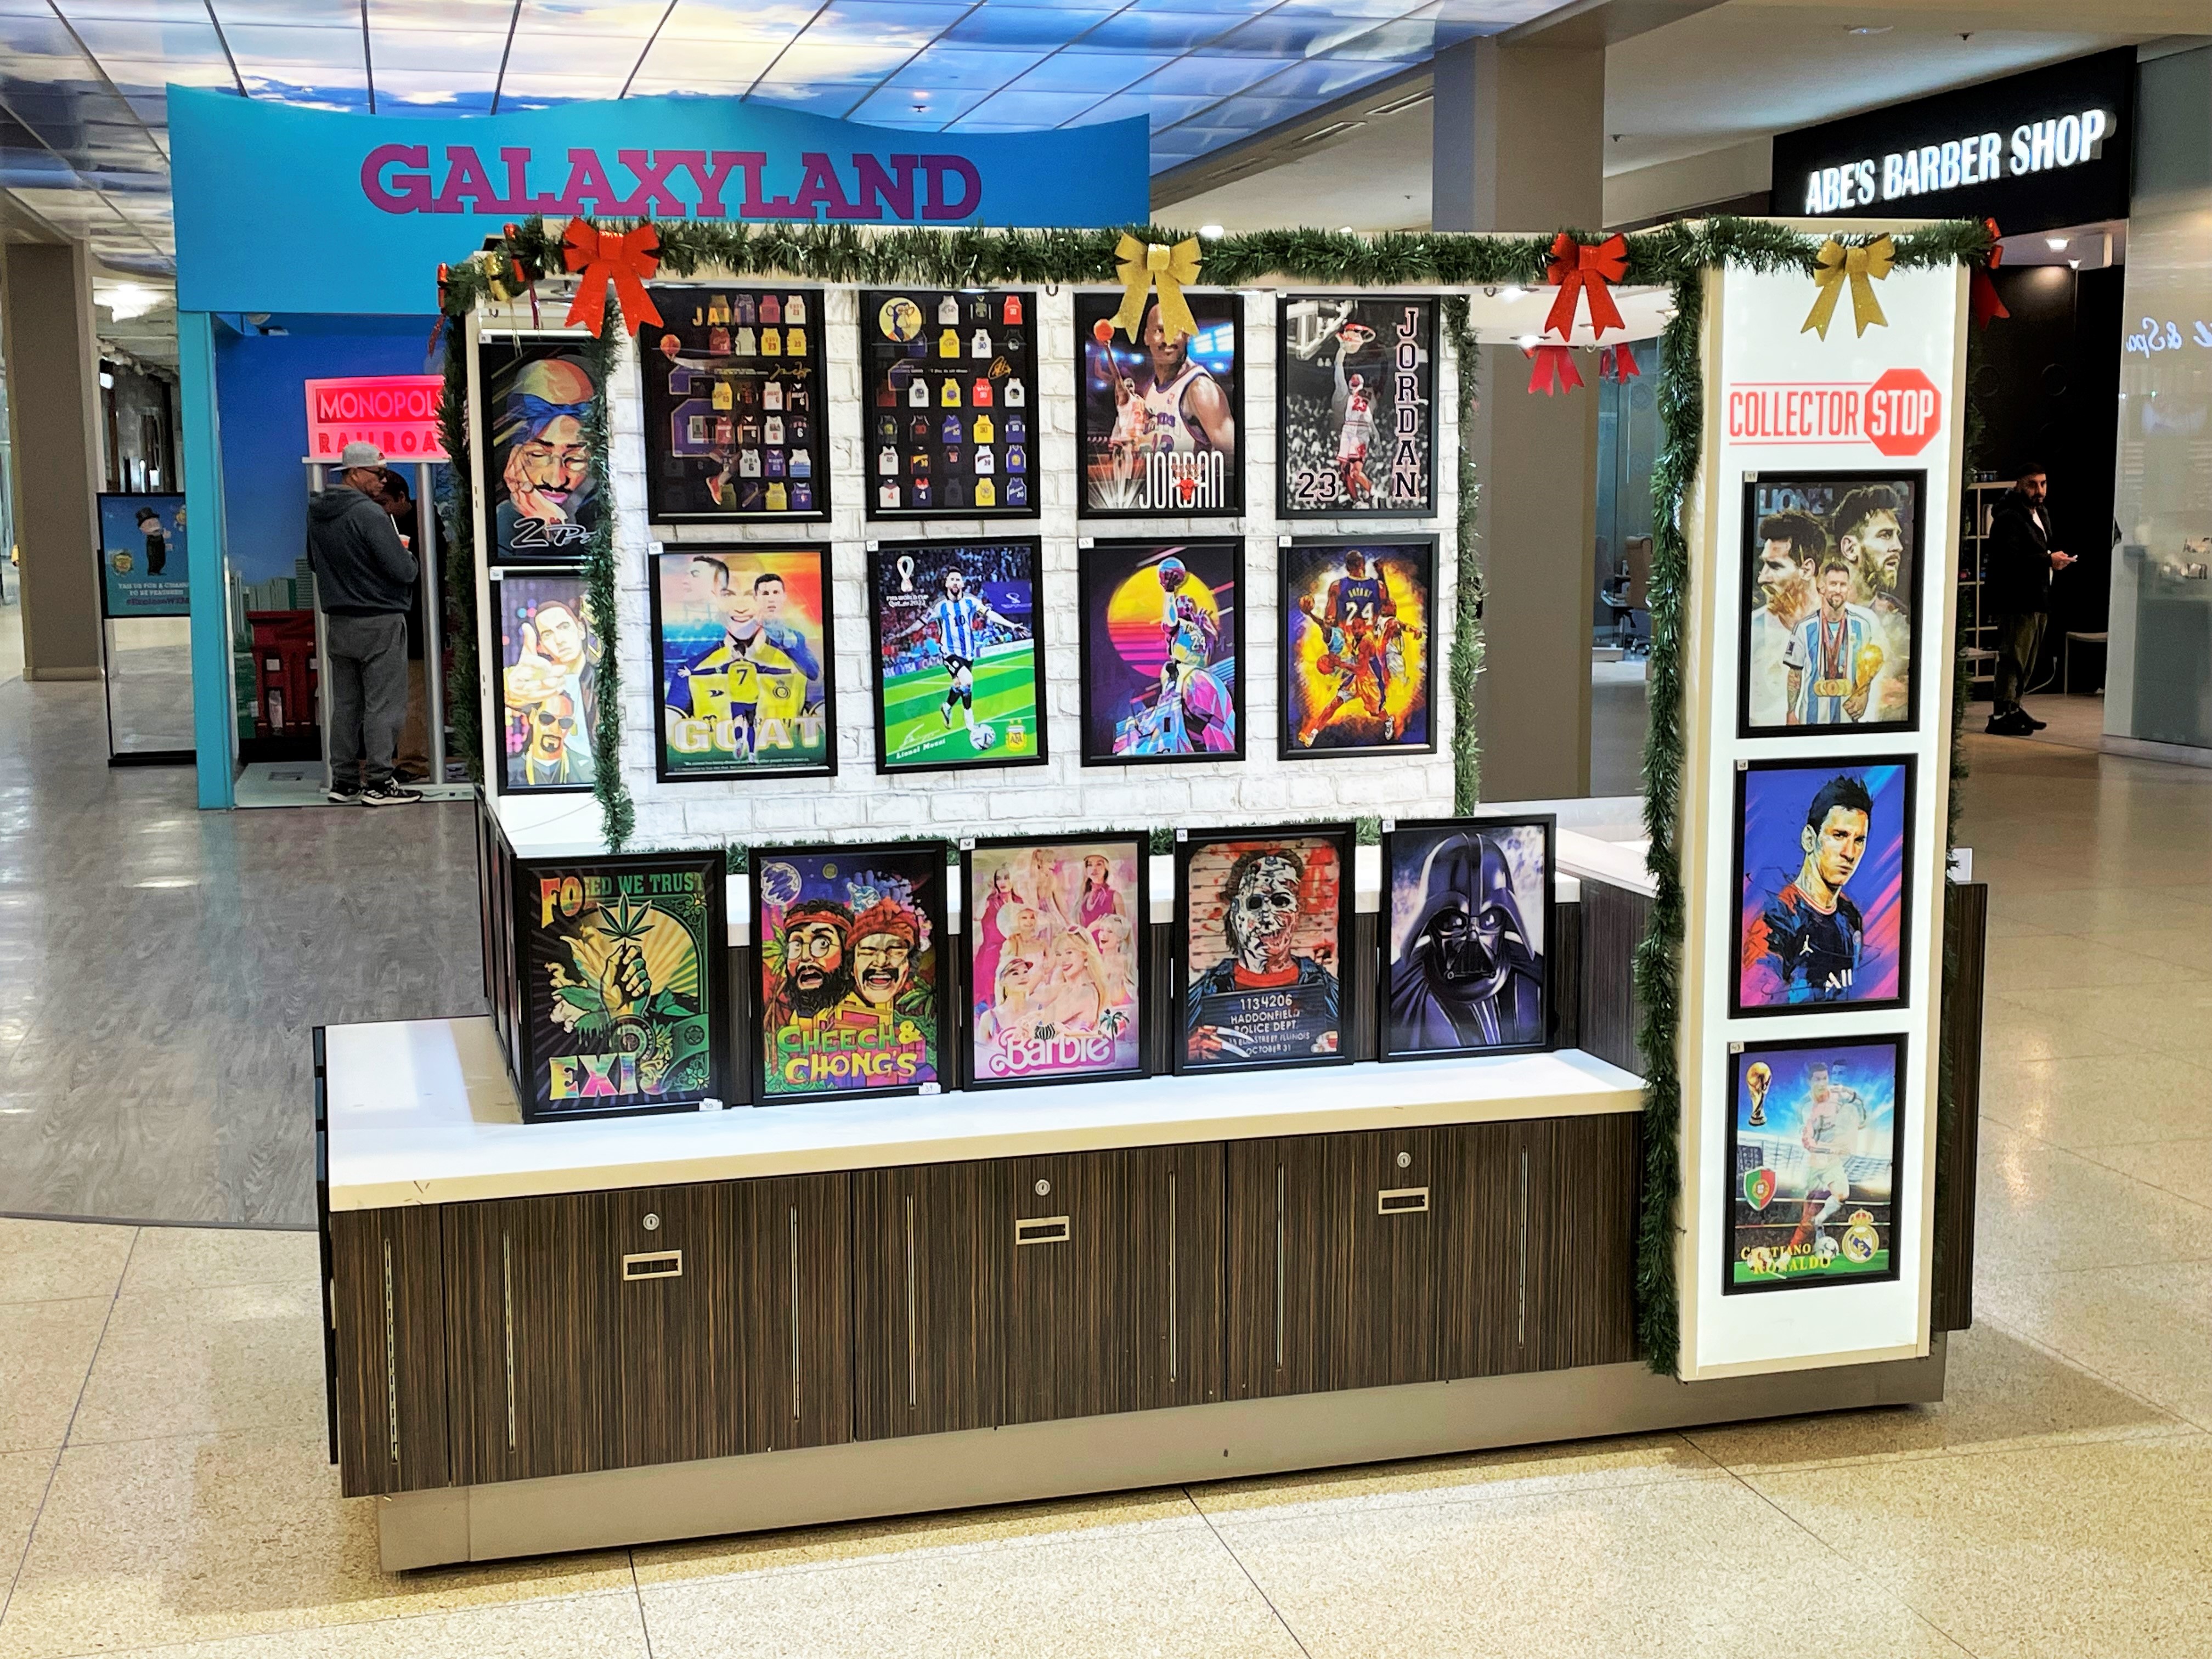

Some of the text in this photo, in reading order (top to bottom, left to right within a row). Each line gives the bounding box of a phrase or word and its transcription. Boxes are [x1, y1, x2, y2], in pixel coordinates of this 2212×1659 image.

[1805, 109, 2108, 215] ABE'S BARBER SHOP
[360, 143, 982, 221] GALAXYLAND
[320, 390, 439, 419] MONOPOL
[1393, 307, 1421, 499] JORDAN
[1730, 388, 1936, 438] COLLECTOR STOP
[1138, 450, 1224, 509] JORDAN
[1296, 469, 1339, 501] 23
[953, 614, 966, 627] 10
[1346, 601, 1374, 625] 24
[1191, 635, 1206, 651] 24
[737, 669, 748, 686] 7
[673, 716, 825, 754] GOAT
[617, 875, 644, 894] WE
[1231, 1009, 1300, 1025] HADDONFIELD
[1234, 1022, 1270, 1035] POLICE
[777, 1020, 922, 1053] CHEECH &
[990, 1027, 1112, 1074] Barbie
[785, 1052, 918, 1085] CHONG'S
